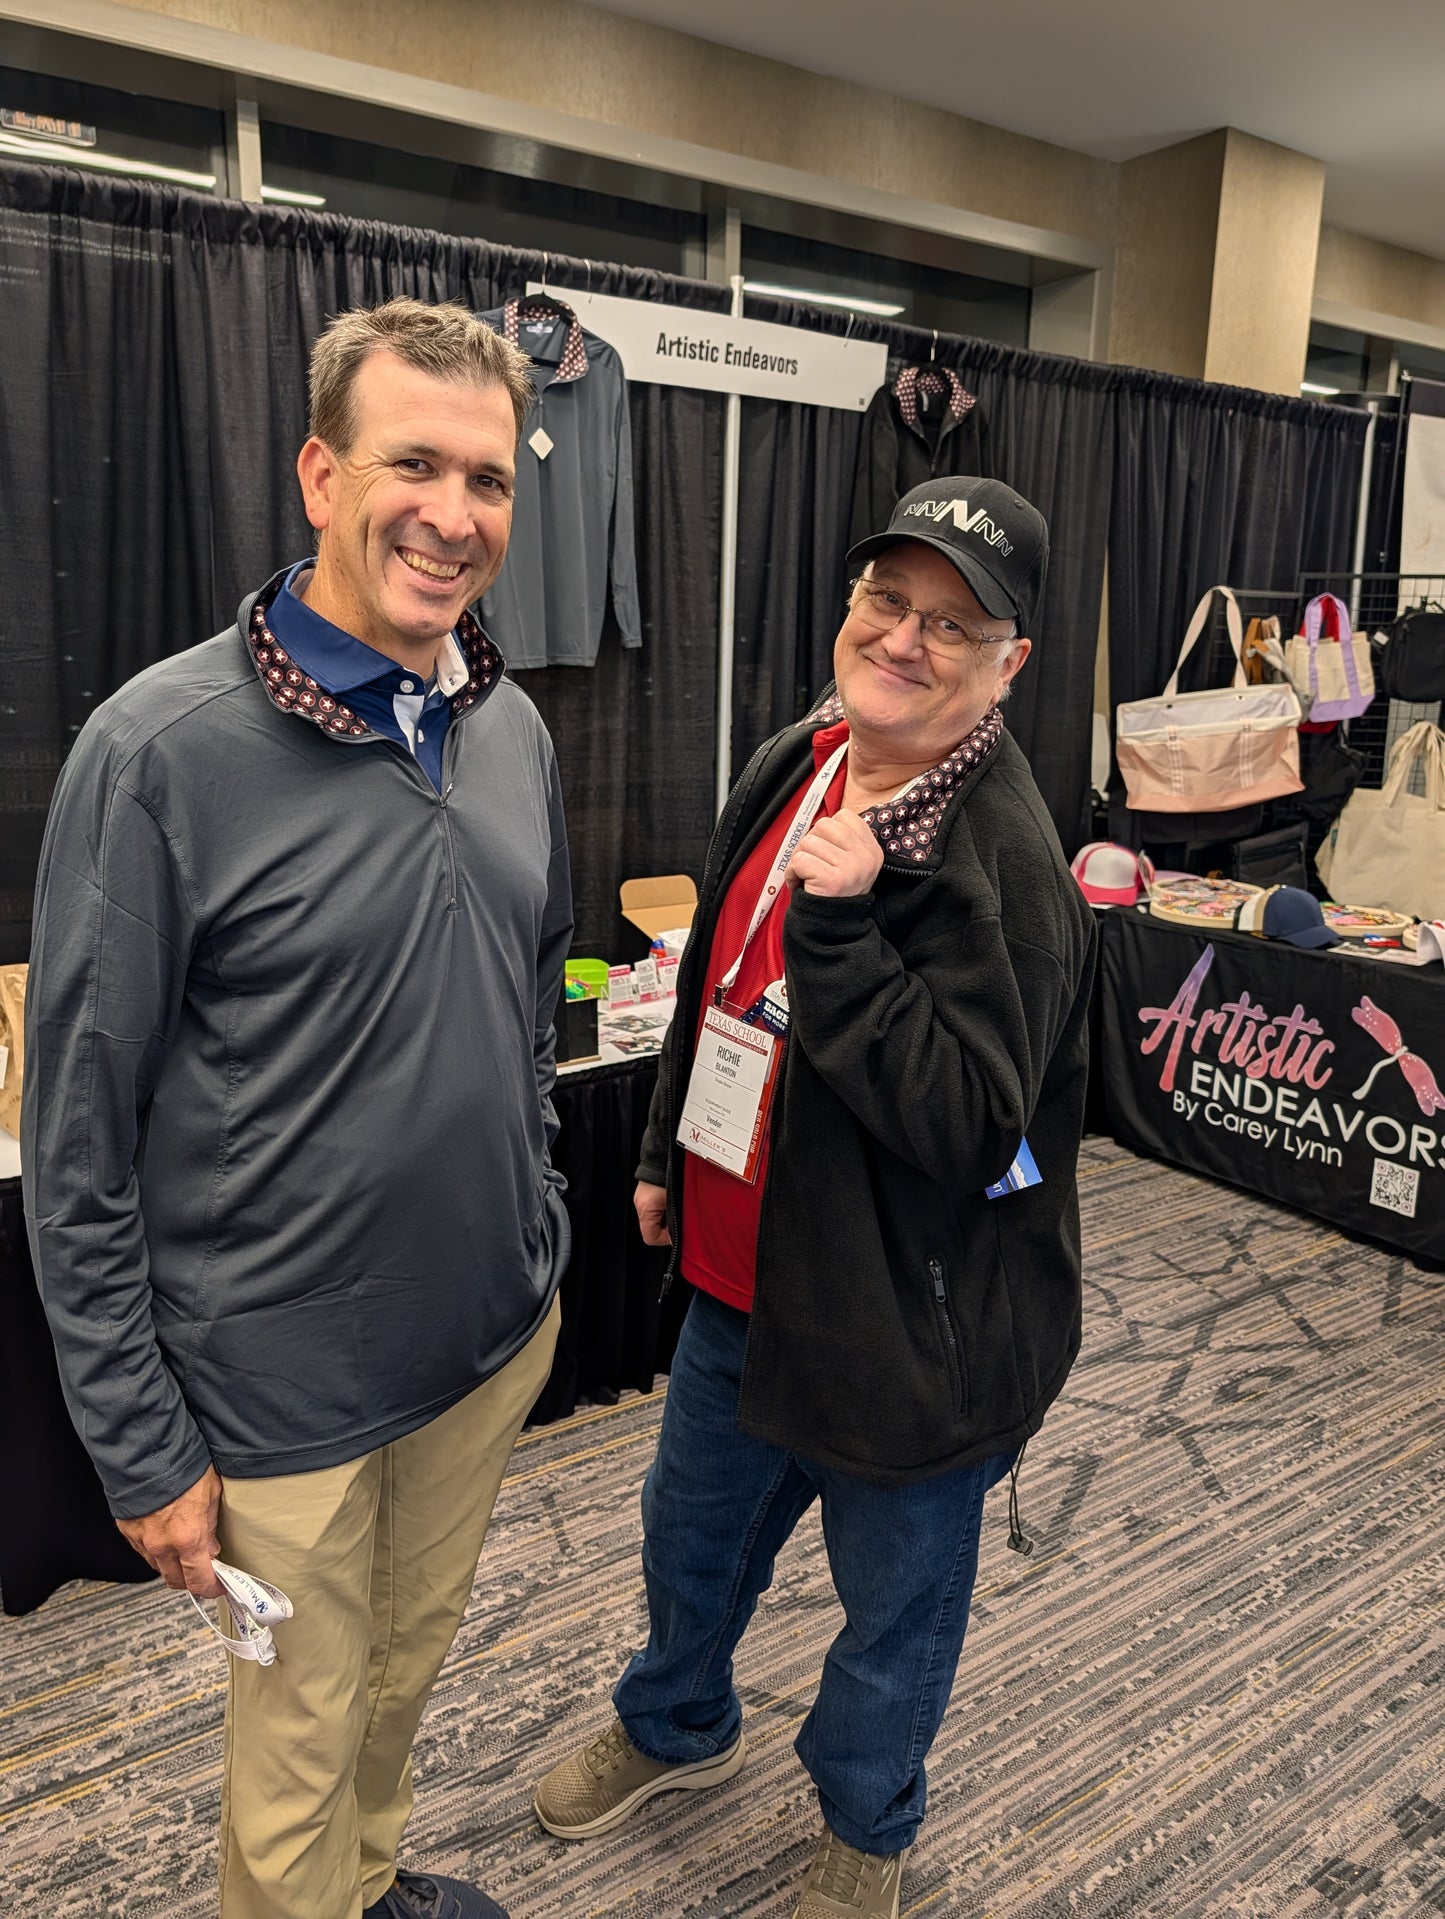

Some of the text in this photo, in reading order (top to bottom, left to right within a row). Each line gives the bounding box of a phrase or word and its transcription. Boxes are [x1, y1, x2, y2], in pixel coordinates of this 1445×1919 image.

[656, 332, 799, 376] Artistic Endeavors
[777, 821, 807, 872] TEXAS SCHOOL
[708, 1011, 767, 1048] TEXAS SCHOOL
[762, 1011, 786, 1031] FOR MORE
[763, 1001, 789, 1025] BACK
[1138, 942, 1336, 1093] Artistic
[715, 1062, 737, 1078] BLANTON
[716, 1045, 742, 1067] RICHIE
[706, 1114, 722, 1128] Vendor
[1173, 1089, 1344, 1168] By Carey Lynn
[228, 1569, 260, 1604] MILLER'S
